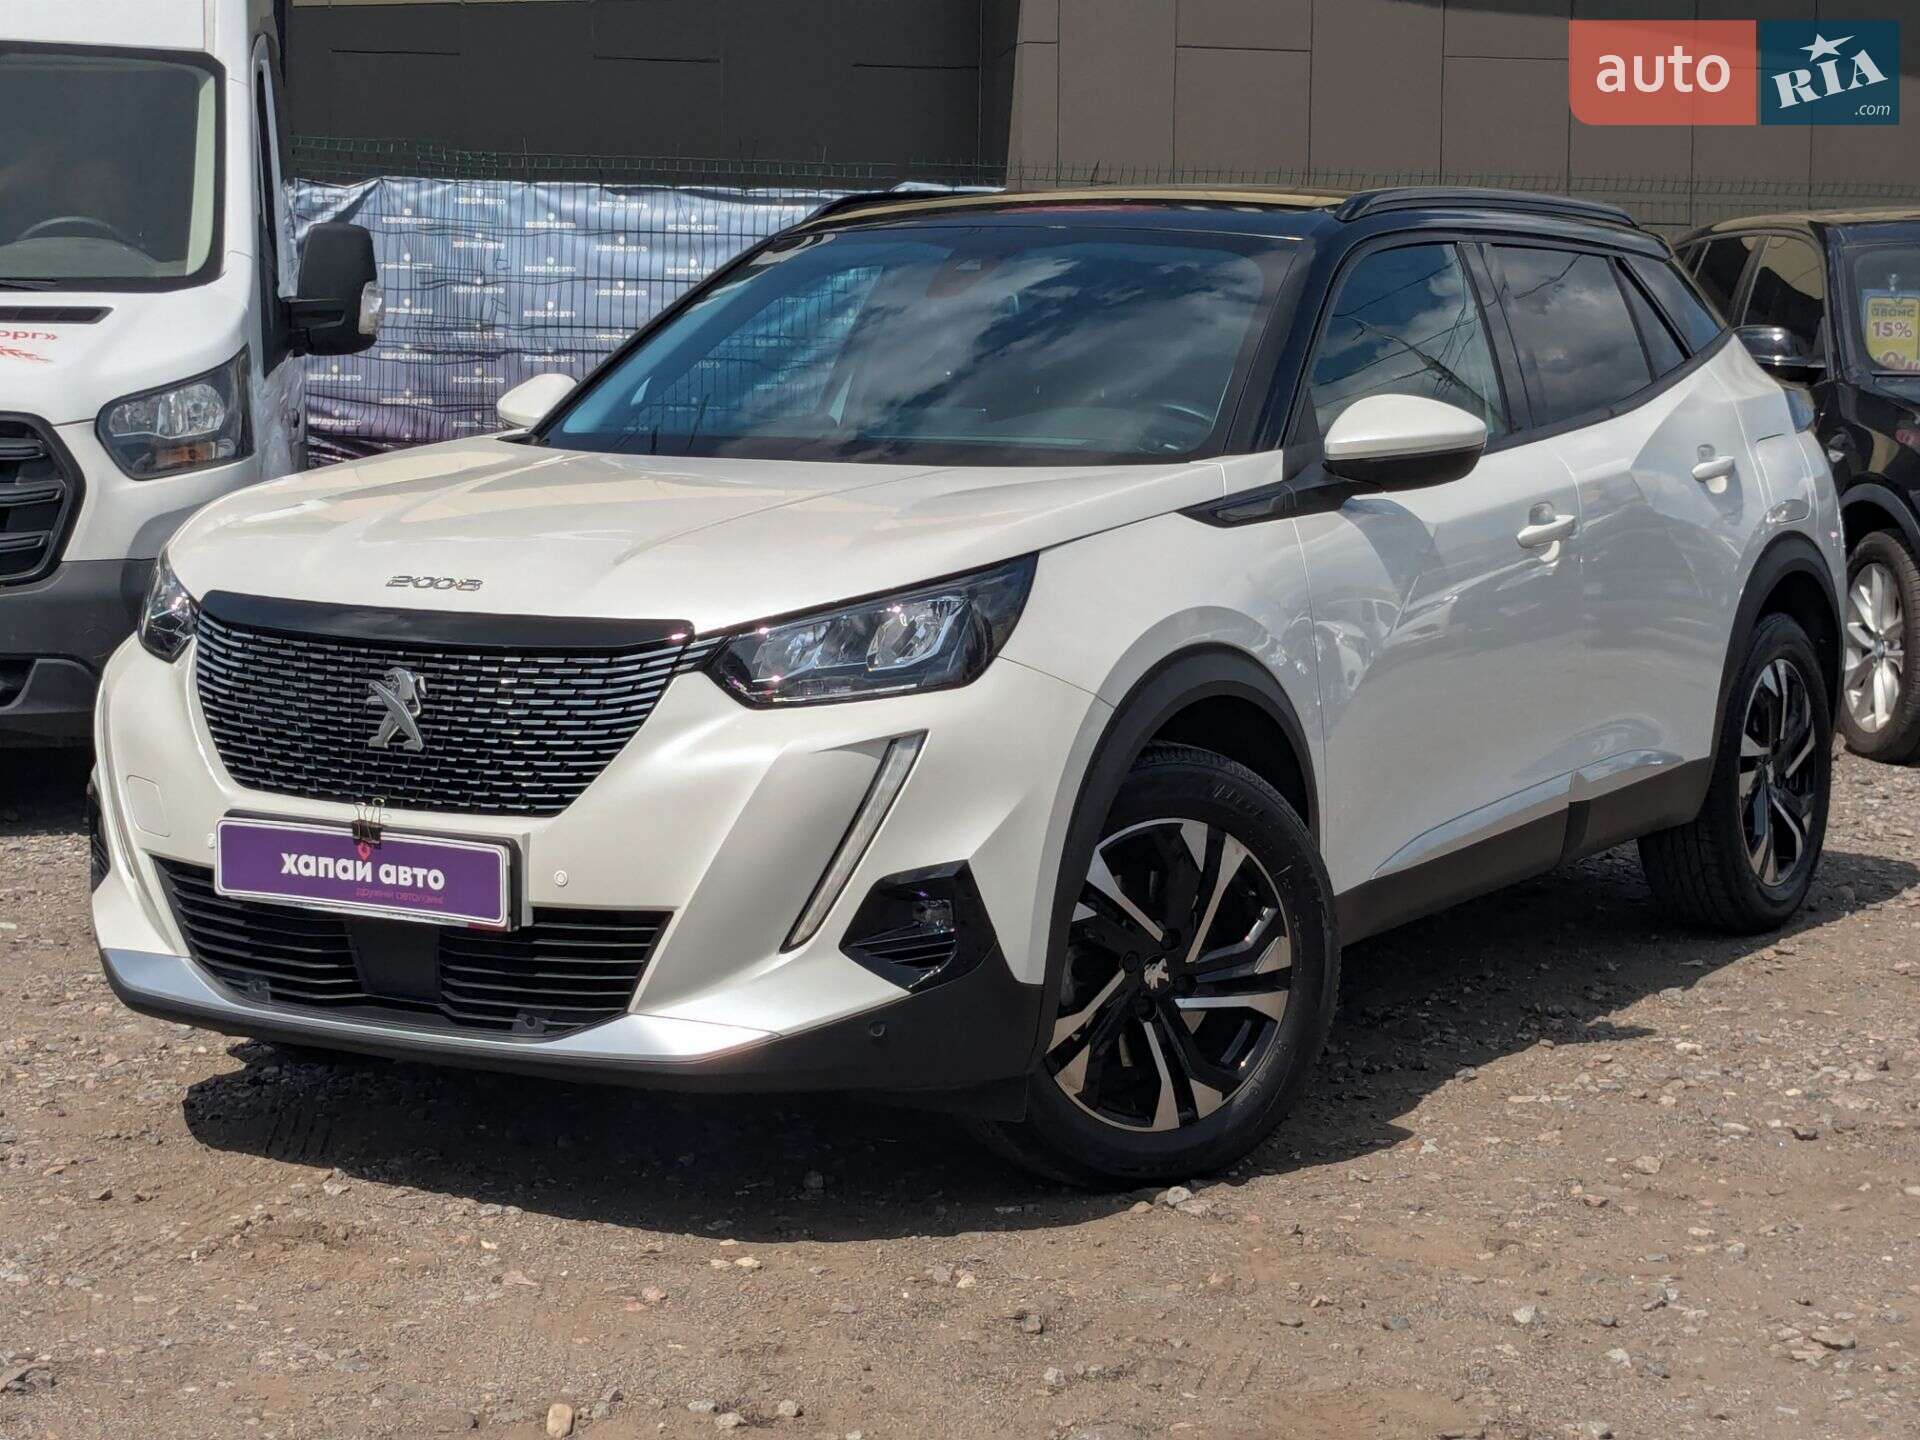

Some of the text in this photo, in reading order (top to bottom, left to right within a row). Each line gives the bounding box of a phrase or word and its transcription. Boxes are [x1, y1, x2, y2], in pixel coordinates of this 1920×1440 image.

[1872, 321, 1913, 338] 15%
[385, 575, 483, 592] 2008
[378, 863, 446, 891] авто
